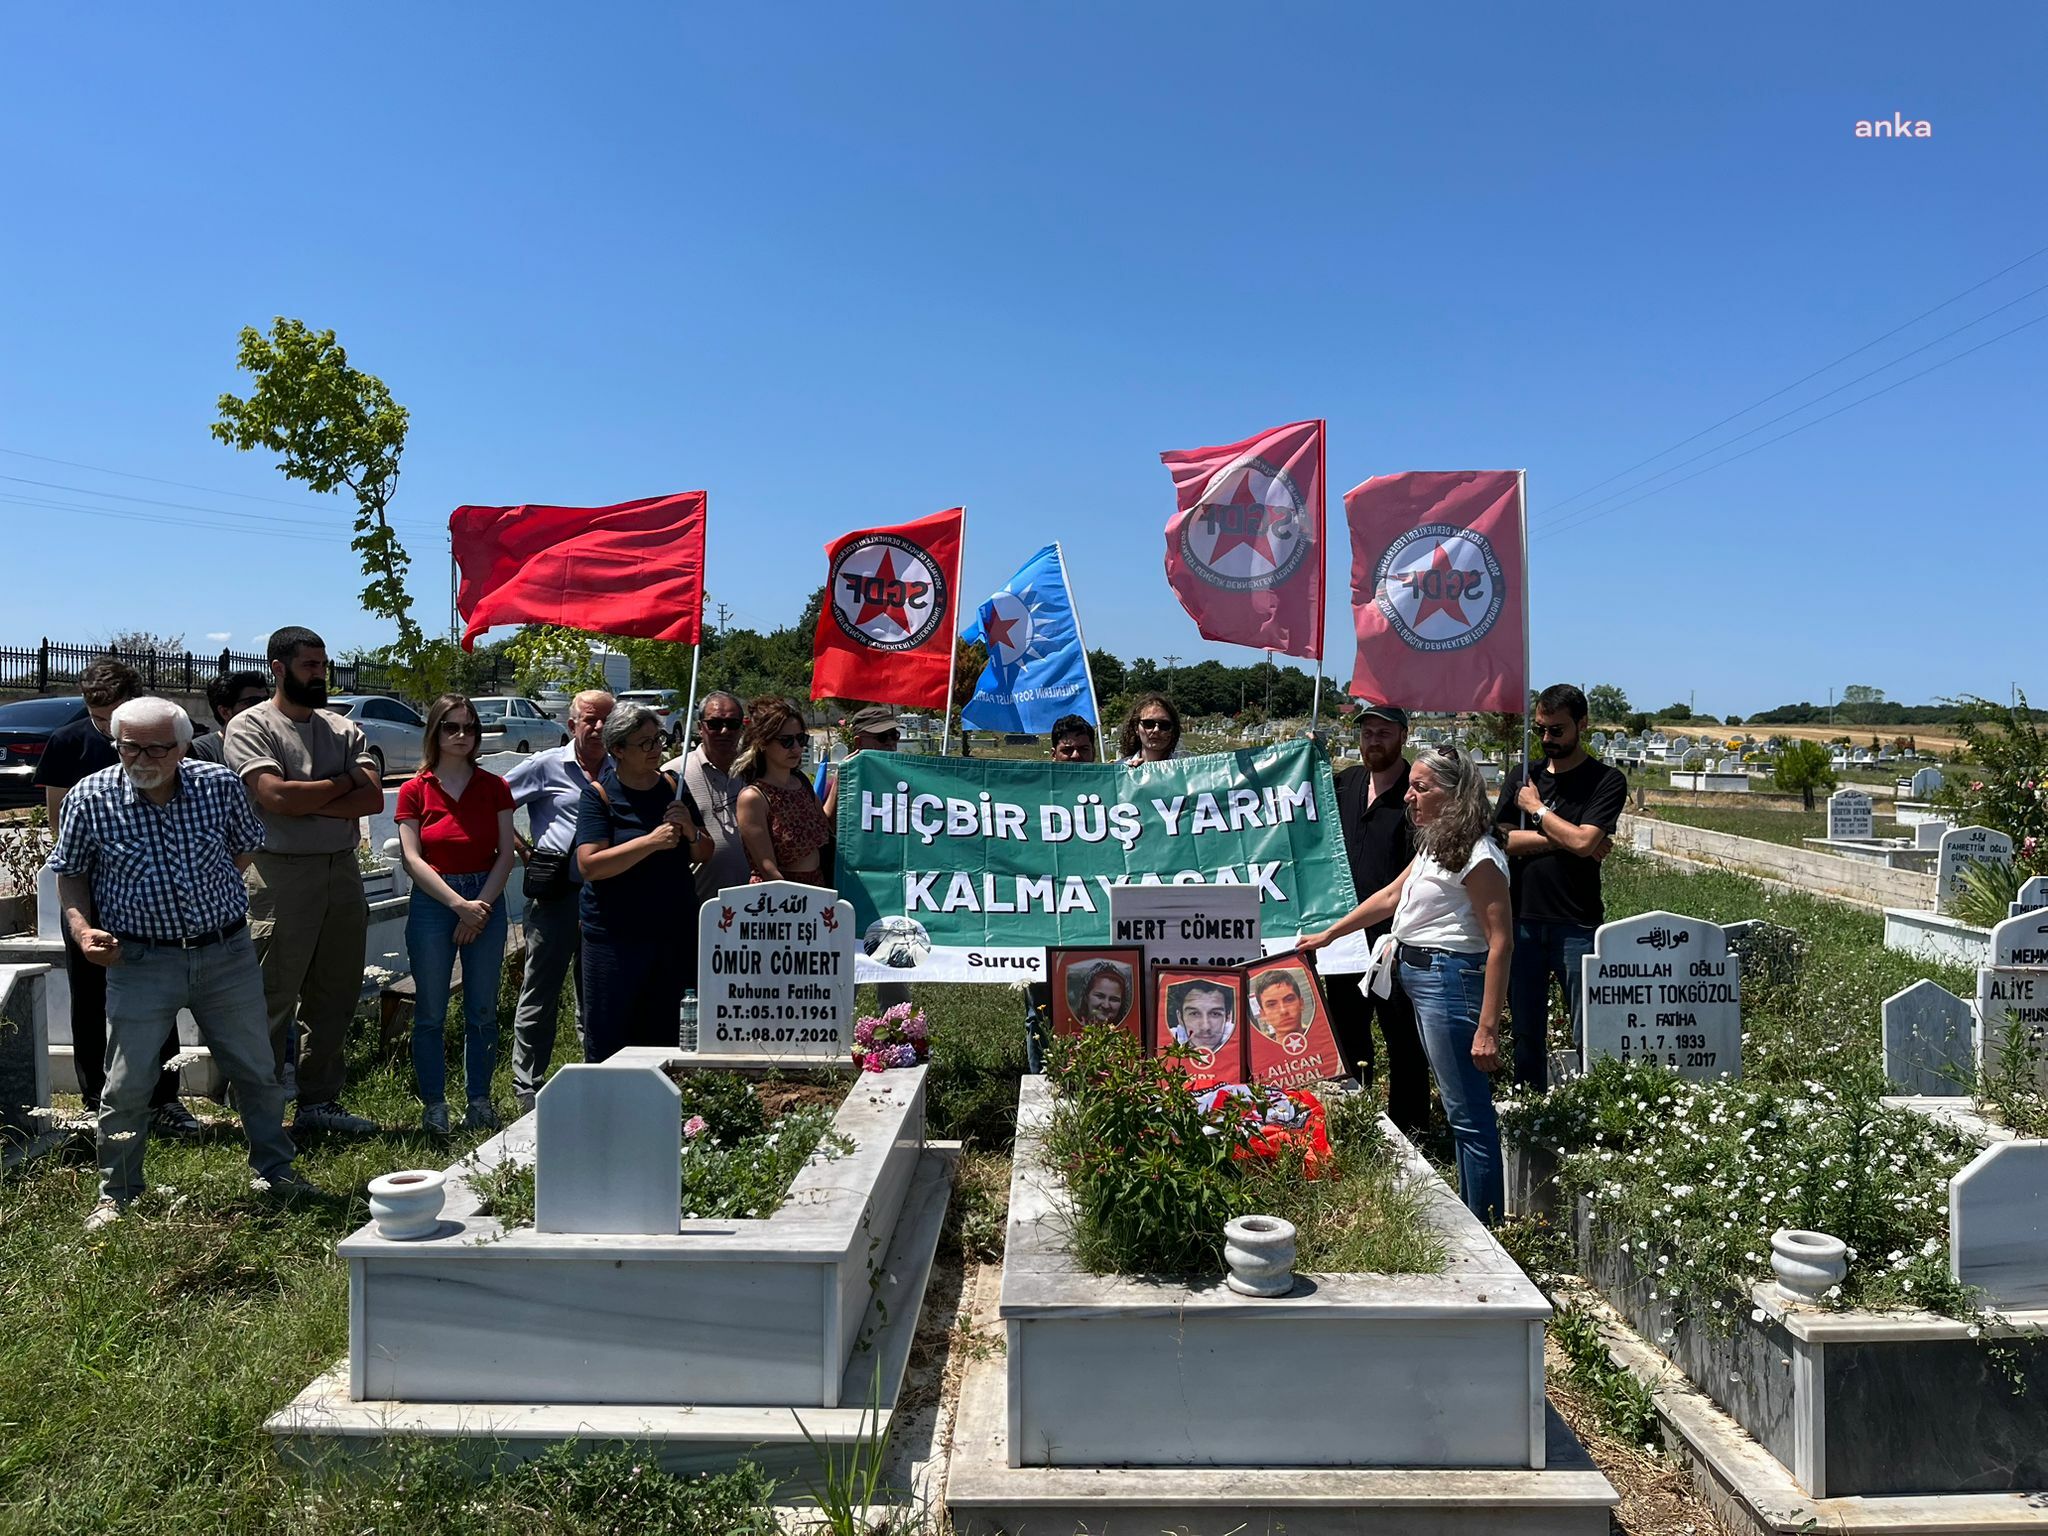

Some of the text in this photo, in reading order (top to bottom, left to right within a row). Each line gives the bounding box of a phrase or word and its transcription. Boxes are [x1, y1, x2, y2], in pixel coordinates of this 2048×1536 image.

[861, 781, 1318, 850] HİÇBİR DÜŞ YARIM
[1990, 844, 2008, 854] OĞLU
[740, 919, 817, 945] MEHMET EŞİ
[1117, 913, 1255, 940] MERT CÖMERT
[712, 945, 840, 975] ÖMÜR CÖMERT
[968, 952, 1040, 971] Suruç
[1599, 960, 1725, 978] ABDULLAH OĞLU
[729, 983, 831, 1000] Ruhuna Fatiha
[1589, 981, 1738, 1004] MEHMET TOKGÖZOL
[1990, 977, 2034, 1000] ALİYE
[1656, 1011, 1697, 1026] FATİHA
[1268, 1053, 1323, 1079] ALİCAN
[1270, 1068, 1324, 1089] VURAL
